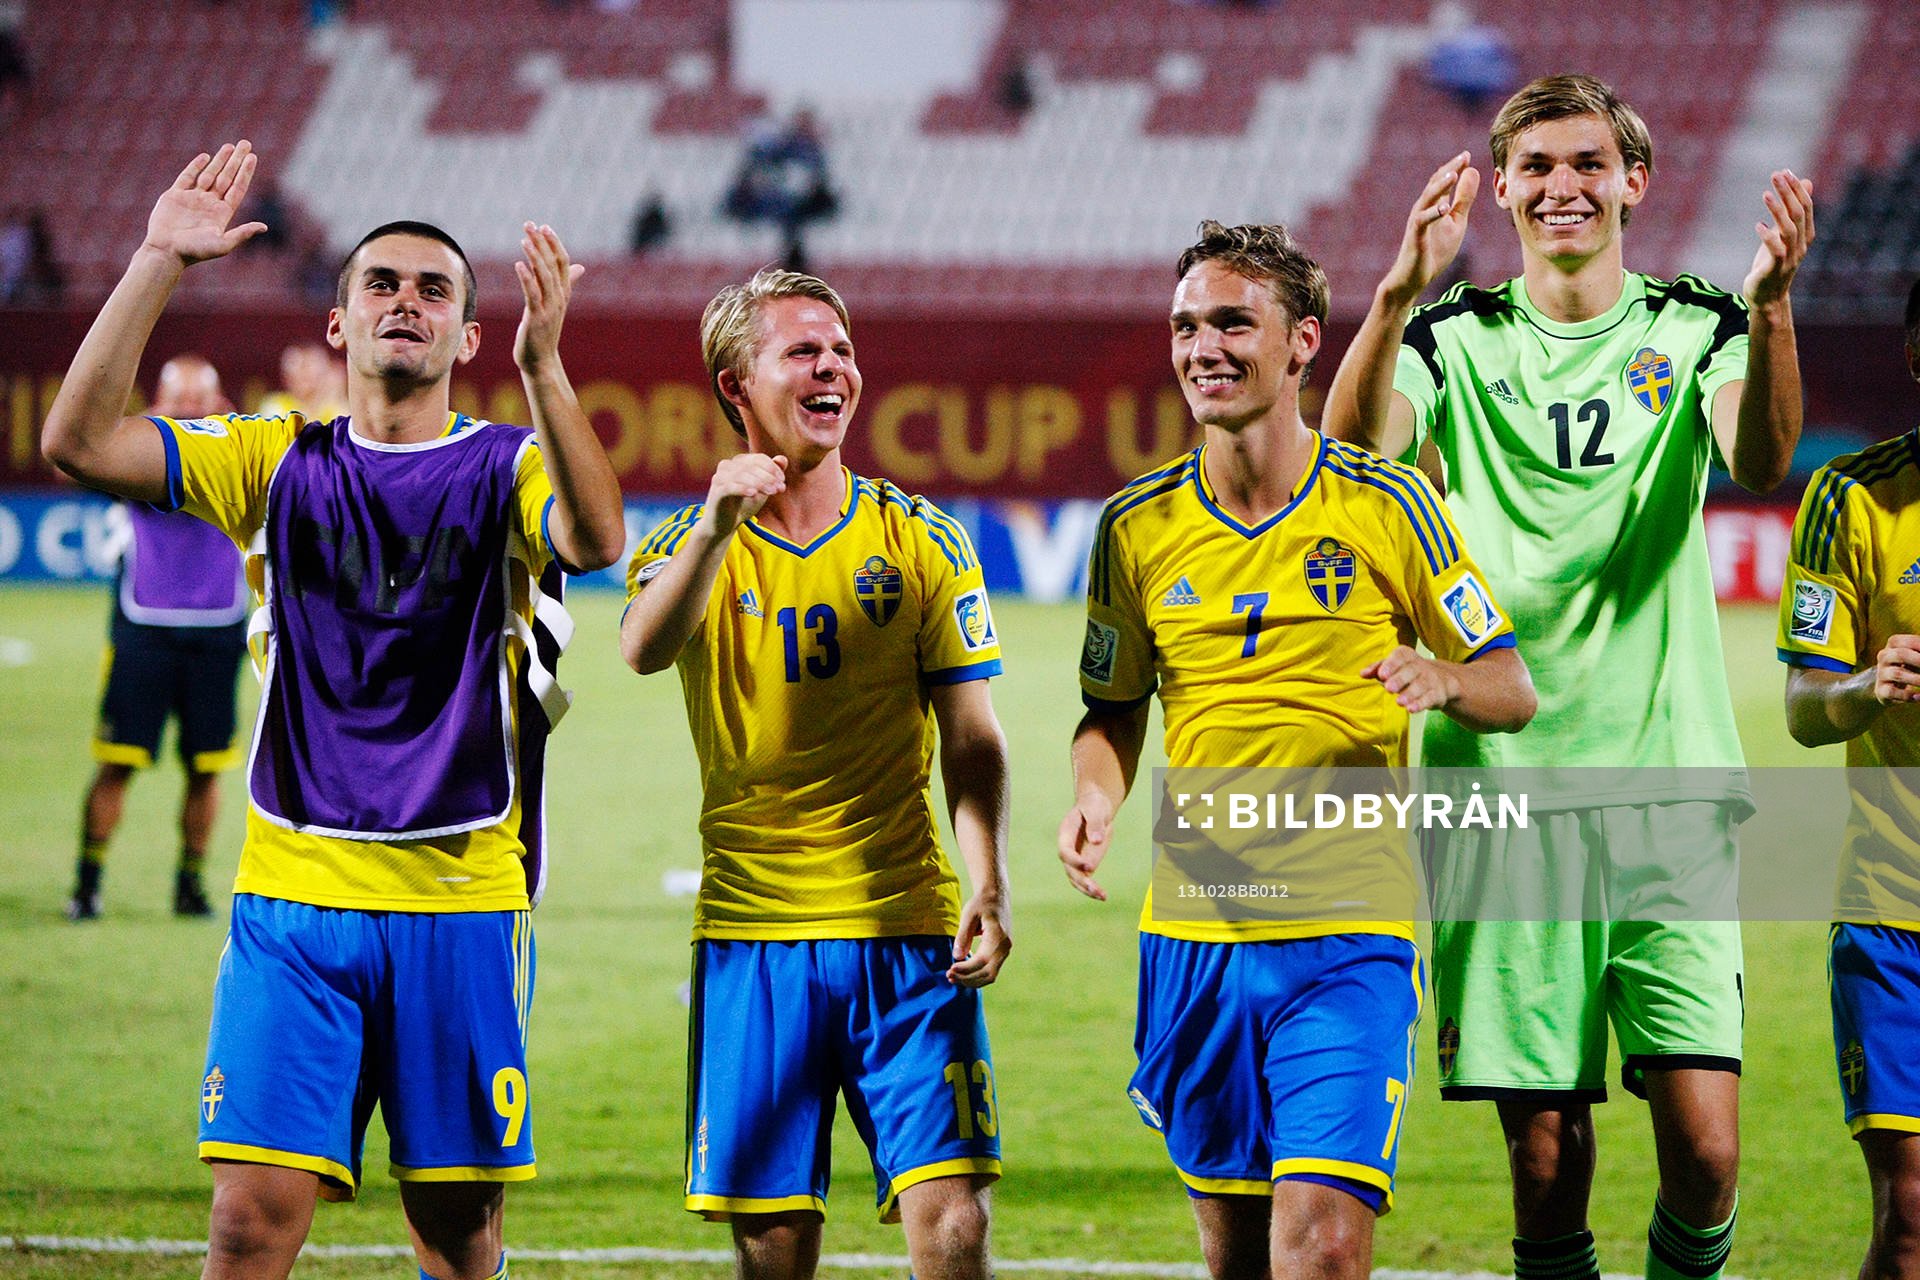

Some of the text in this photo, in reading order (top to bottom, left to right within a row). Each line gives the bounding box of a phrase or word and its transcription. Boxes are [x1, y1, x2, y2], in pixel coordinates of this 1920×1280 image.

[870, 382, 1081, 482] CUP
[1485, 385, 1519, 405] adidas
[1547, 398, 1615, 469] 12
[1162, 595, 1201, 607] adidas
[1231, 592, 1270, 658] 7
[1807, 628, 1824, 637] FIFA
[777, 603, 841, 683] 13
[492, 1067, 527, 1147] 9
[943, 1059, 998, 1139] 13
[1381, 1077, 1404, 1160] 7
